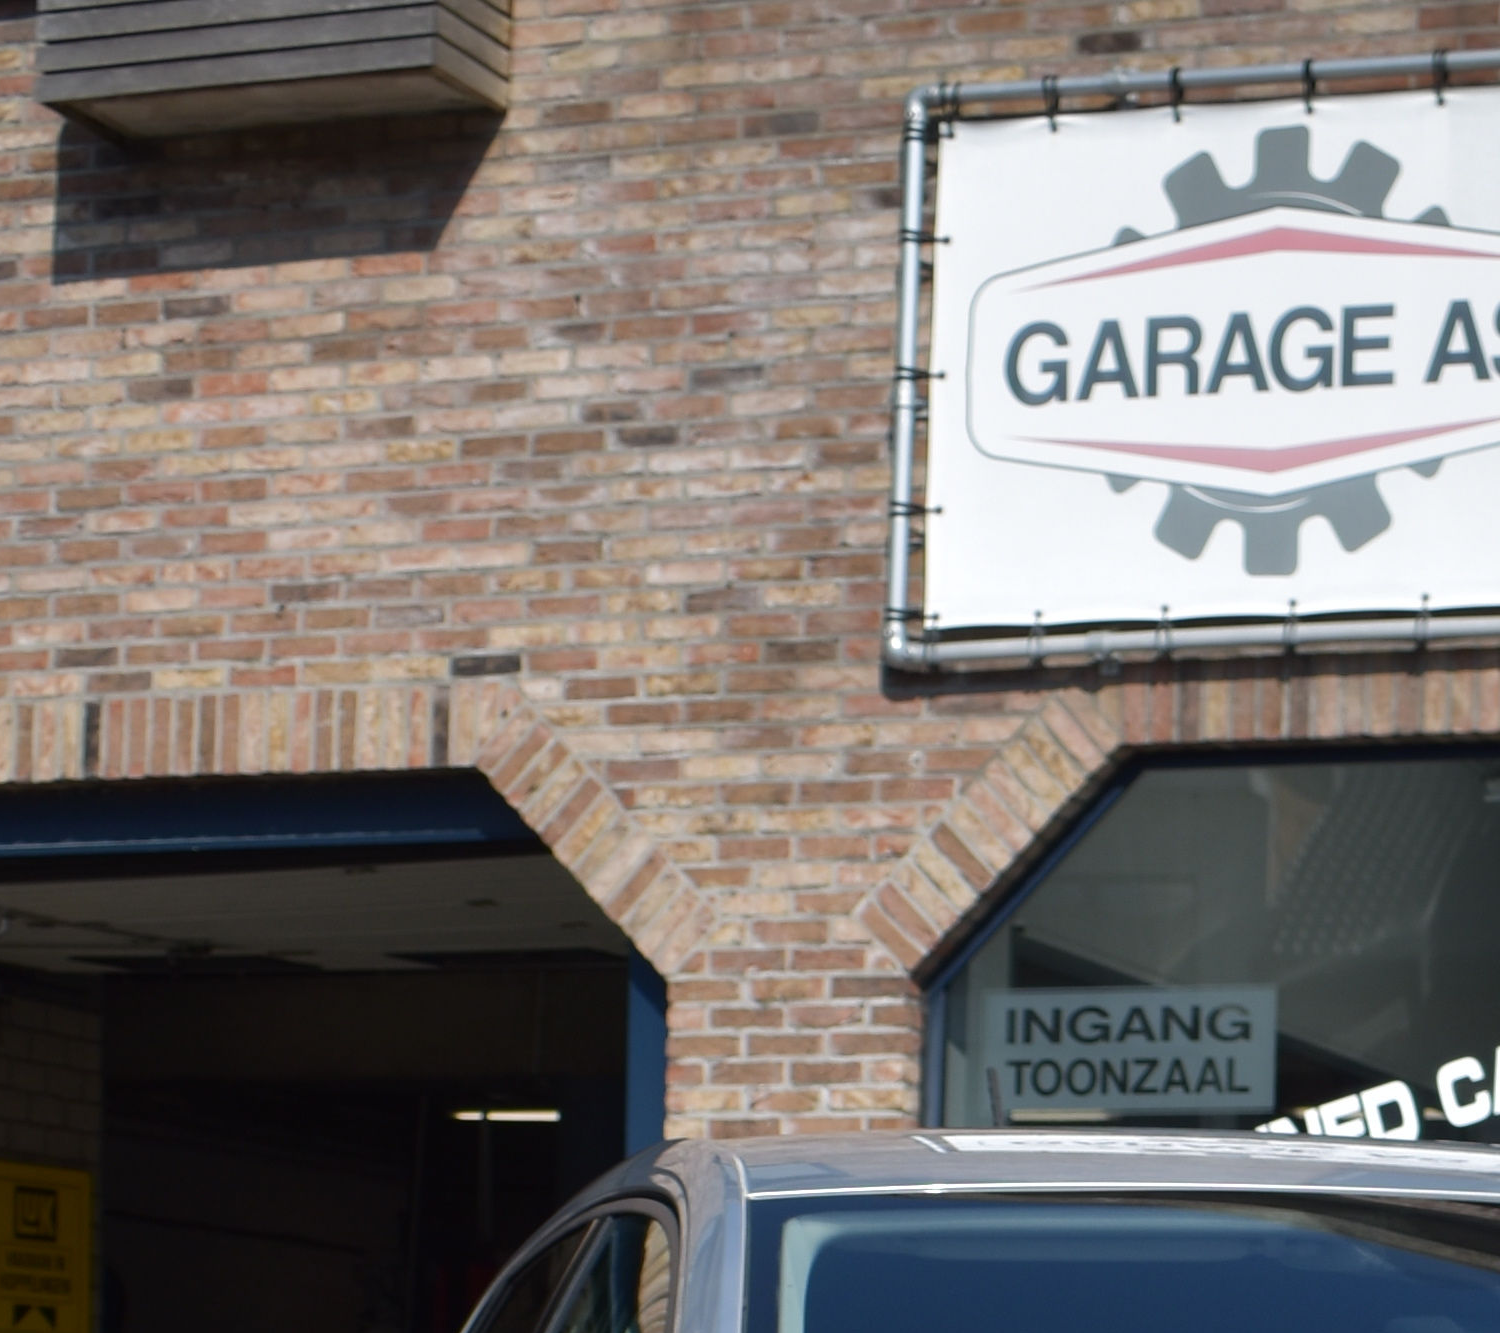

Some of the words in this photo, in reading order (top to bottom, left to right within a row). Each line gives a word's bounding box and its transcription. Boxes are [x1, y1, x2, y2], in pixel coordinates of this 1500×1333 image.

[1005, 305, 1395, 407] GARAGE
[1005, 1004, 1253, 1046] INGANG
[1005, 1056, 1251, 1098] TOONZAAL
